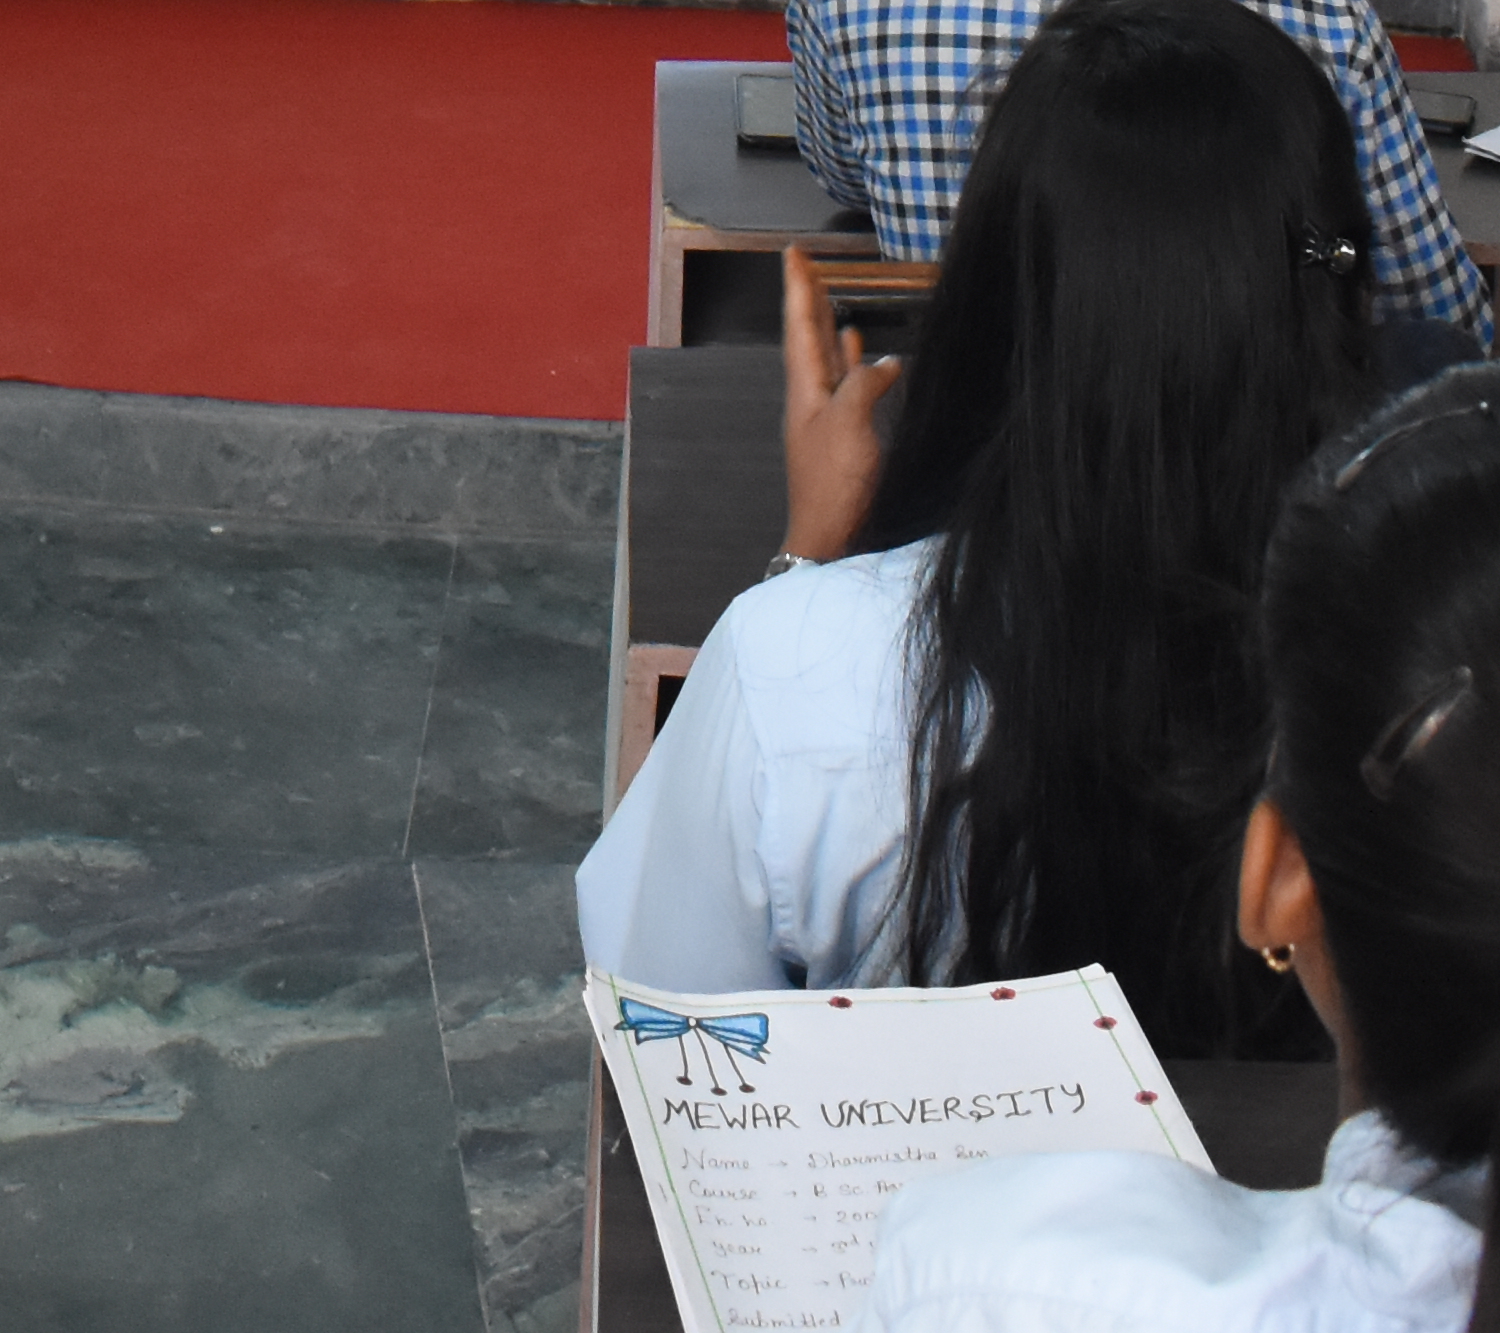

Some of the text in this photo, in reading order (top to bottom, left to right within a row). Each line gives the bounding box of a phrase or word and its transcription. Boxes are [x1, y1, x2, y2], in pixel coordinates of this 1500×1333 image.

[662, 1082, 1087, 1131] MEWAR UNIVERSITY
[681, 1146, 751, 1171] Name
